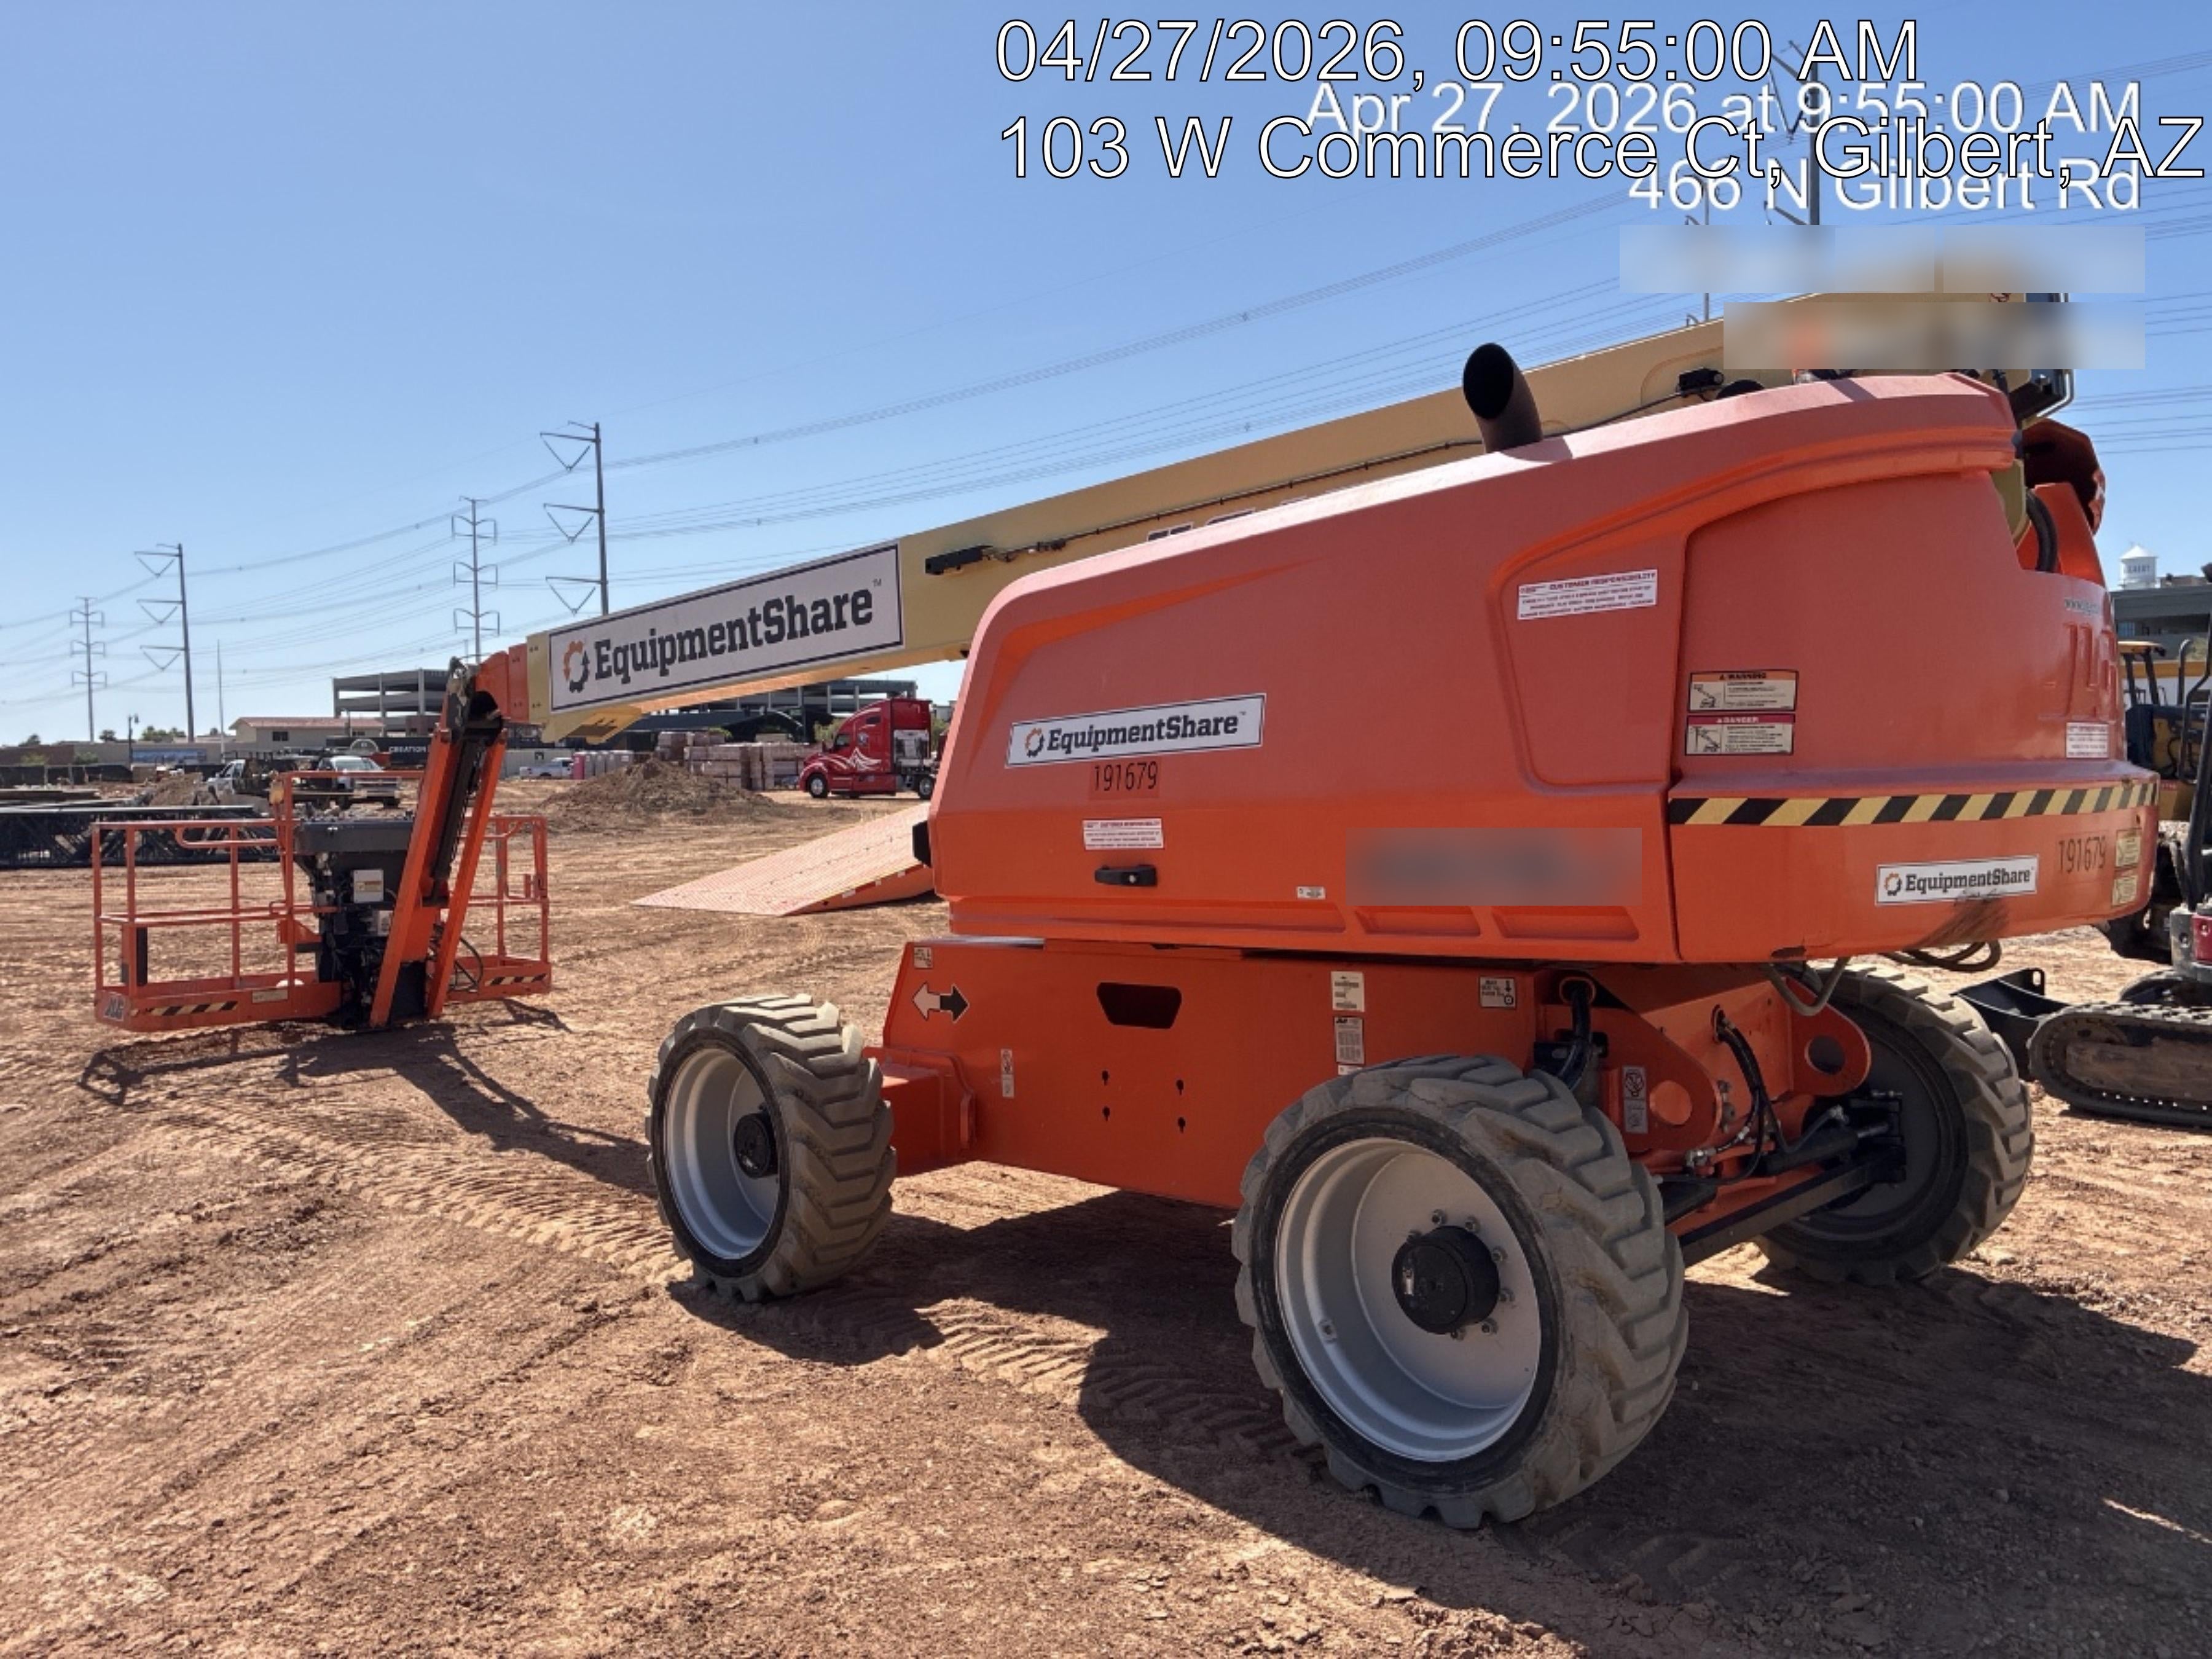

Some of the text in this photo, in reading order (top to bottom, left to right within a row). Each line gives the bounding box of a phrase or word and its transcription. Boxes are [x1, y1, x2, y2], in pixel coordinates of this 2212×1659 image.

[594, 588, 873, 684] EquipmentShare
[1046, 714, 1239, 755] EquipmentShare
[1094, 760, 1159, 791] 191679
[2058, 835, 2106, 874] 191679
[1905, 867, 2031, 895] EquipmentShare
